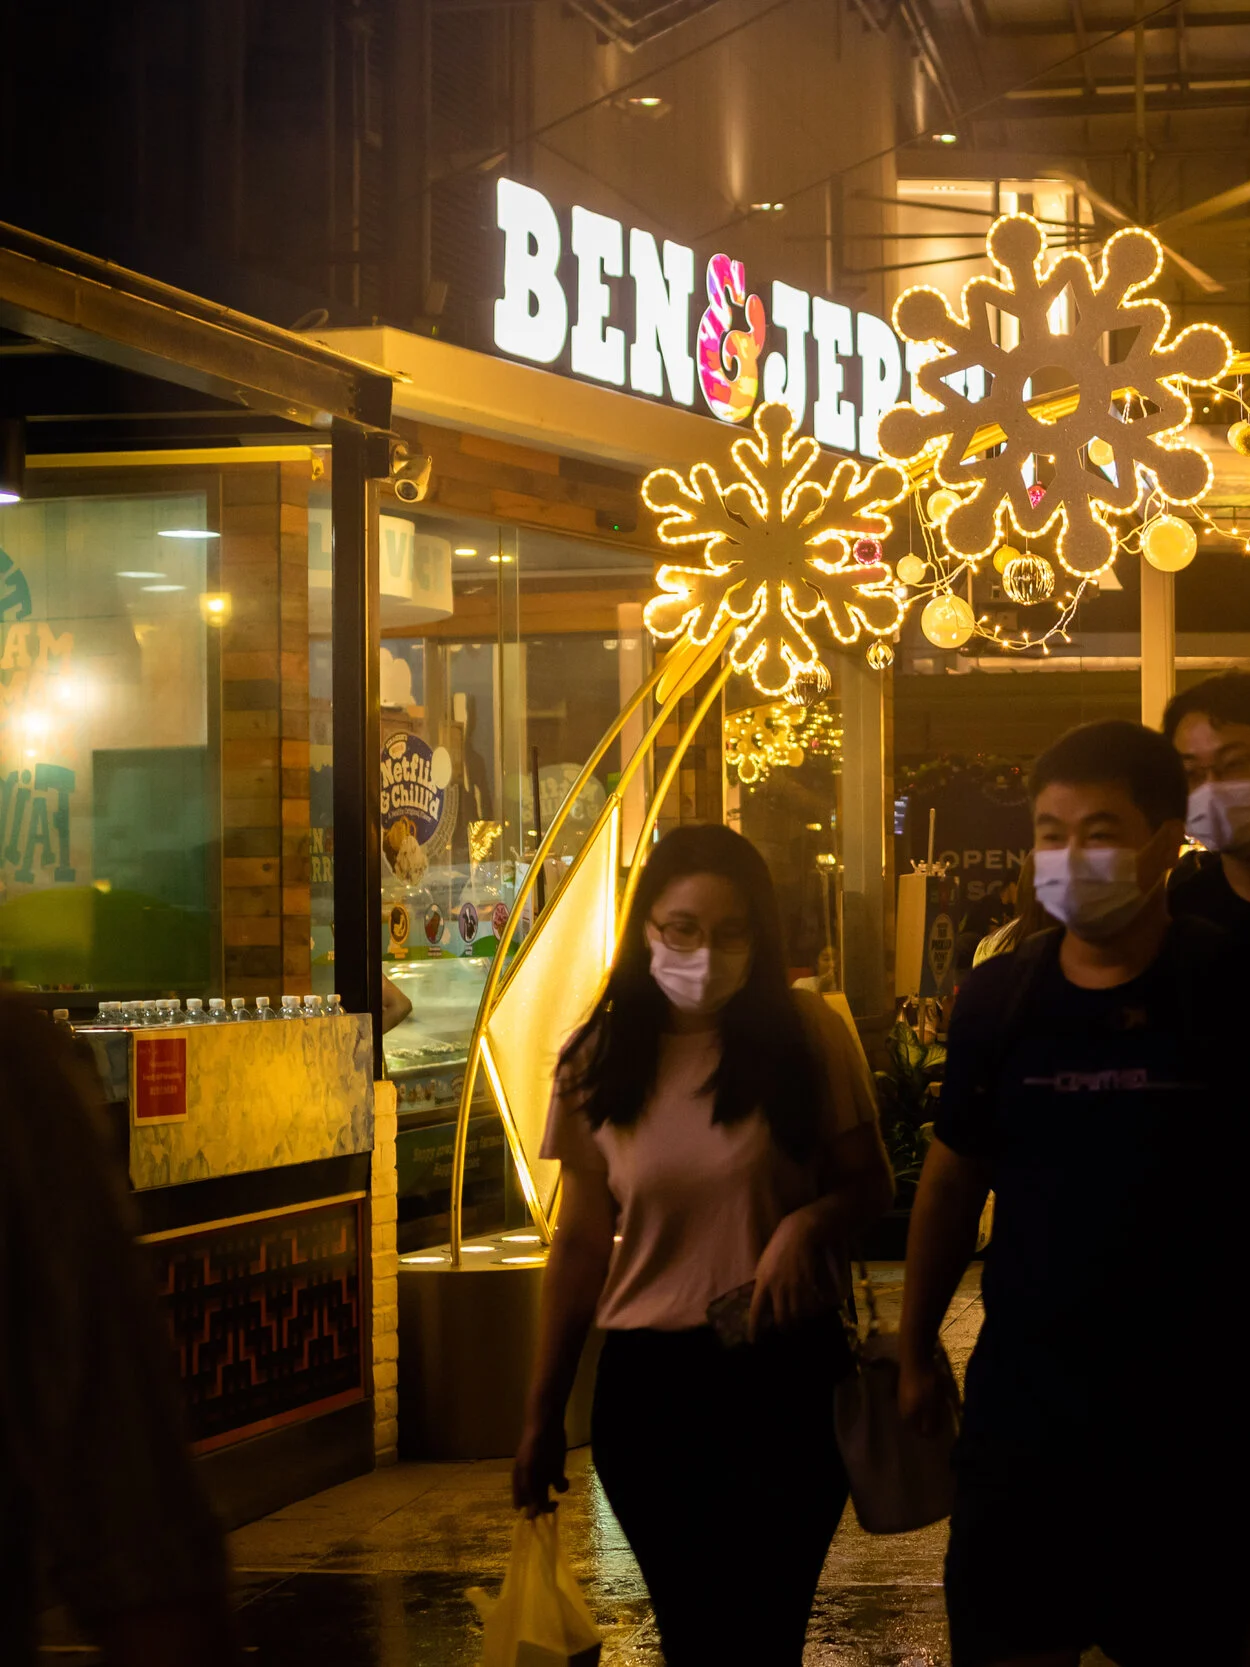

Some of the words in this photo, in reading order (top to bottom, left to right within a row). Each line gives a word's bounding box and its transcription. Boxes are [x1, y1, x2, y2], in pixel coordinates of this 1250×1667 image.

[494, 177, 695, 406] BEN
[699, 252, 766, 423] &
[380, 752, 437, 795] Netfli
